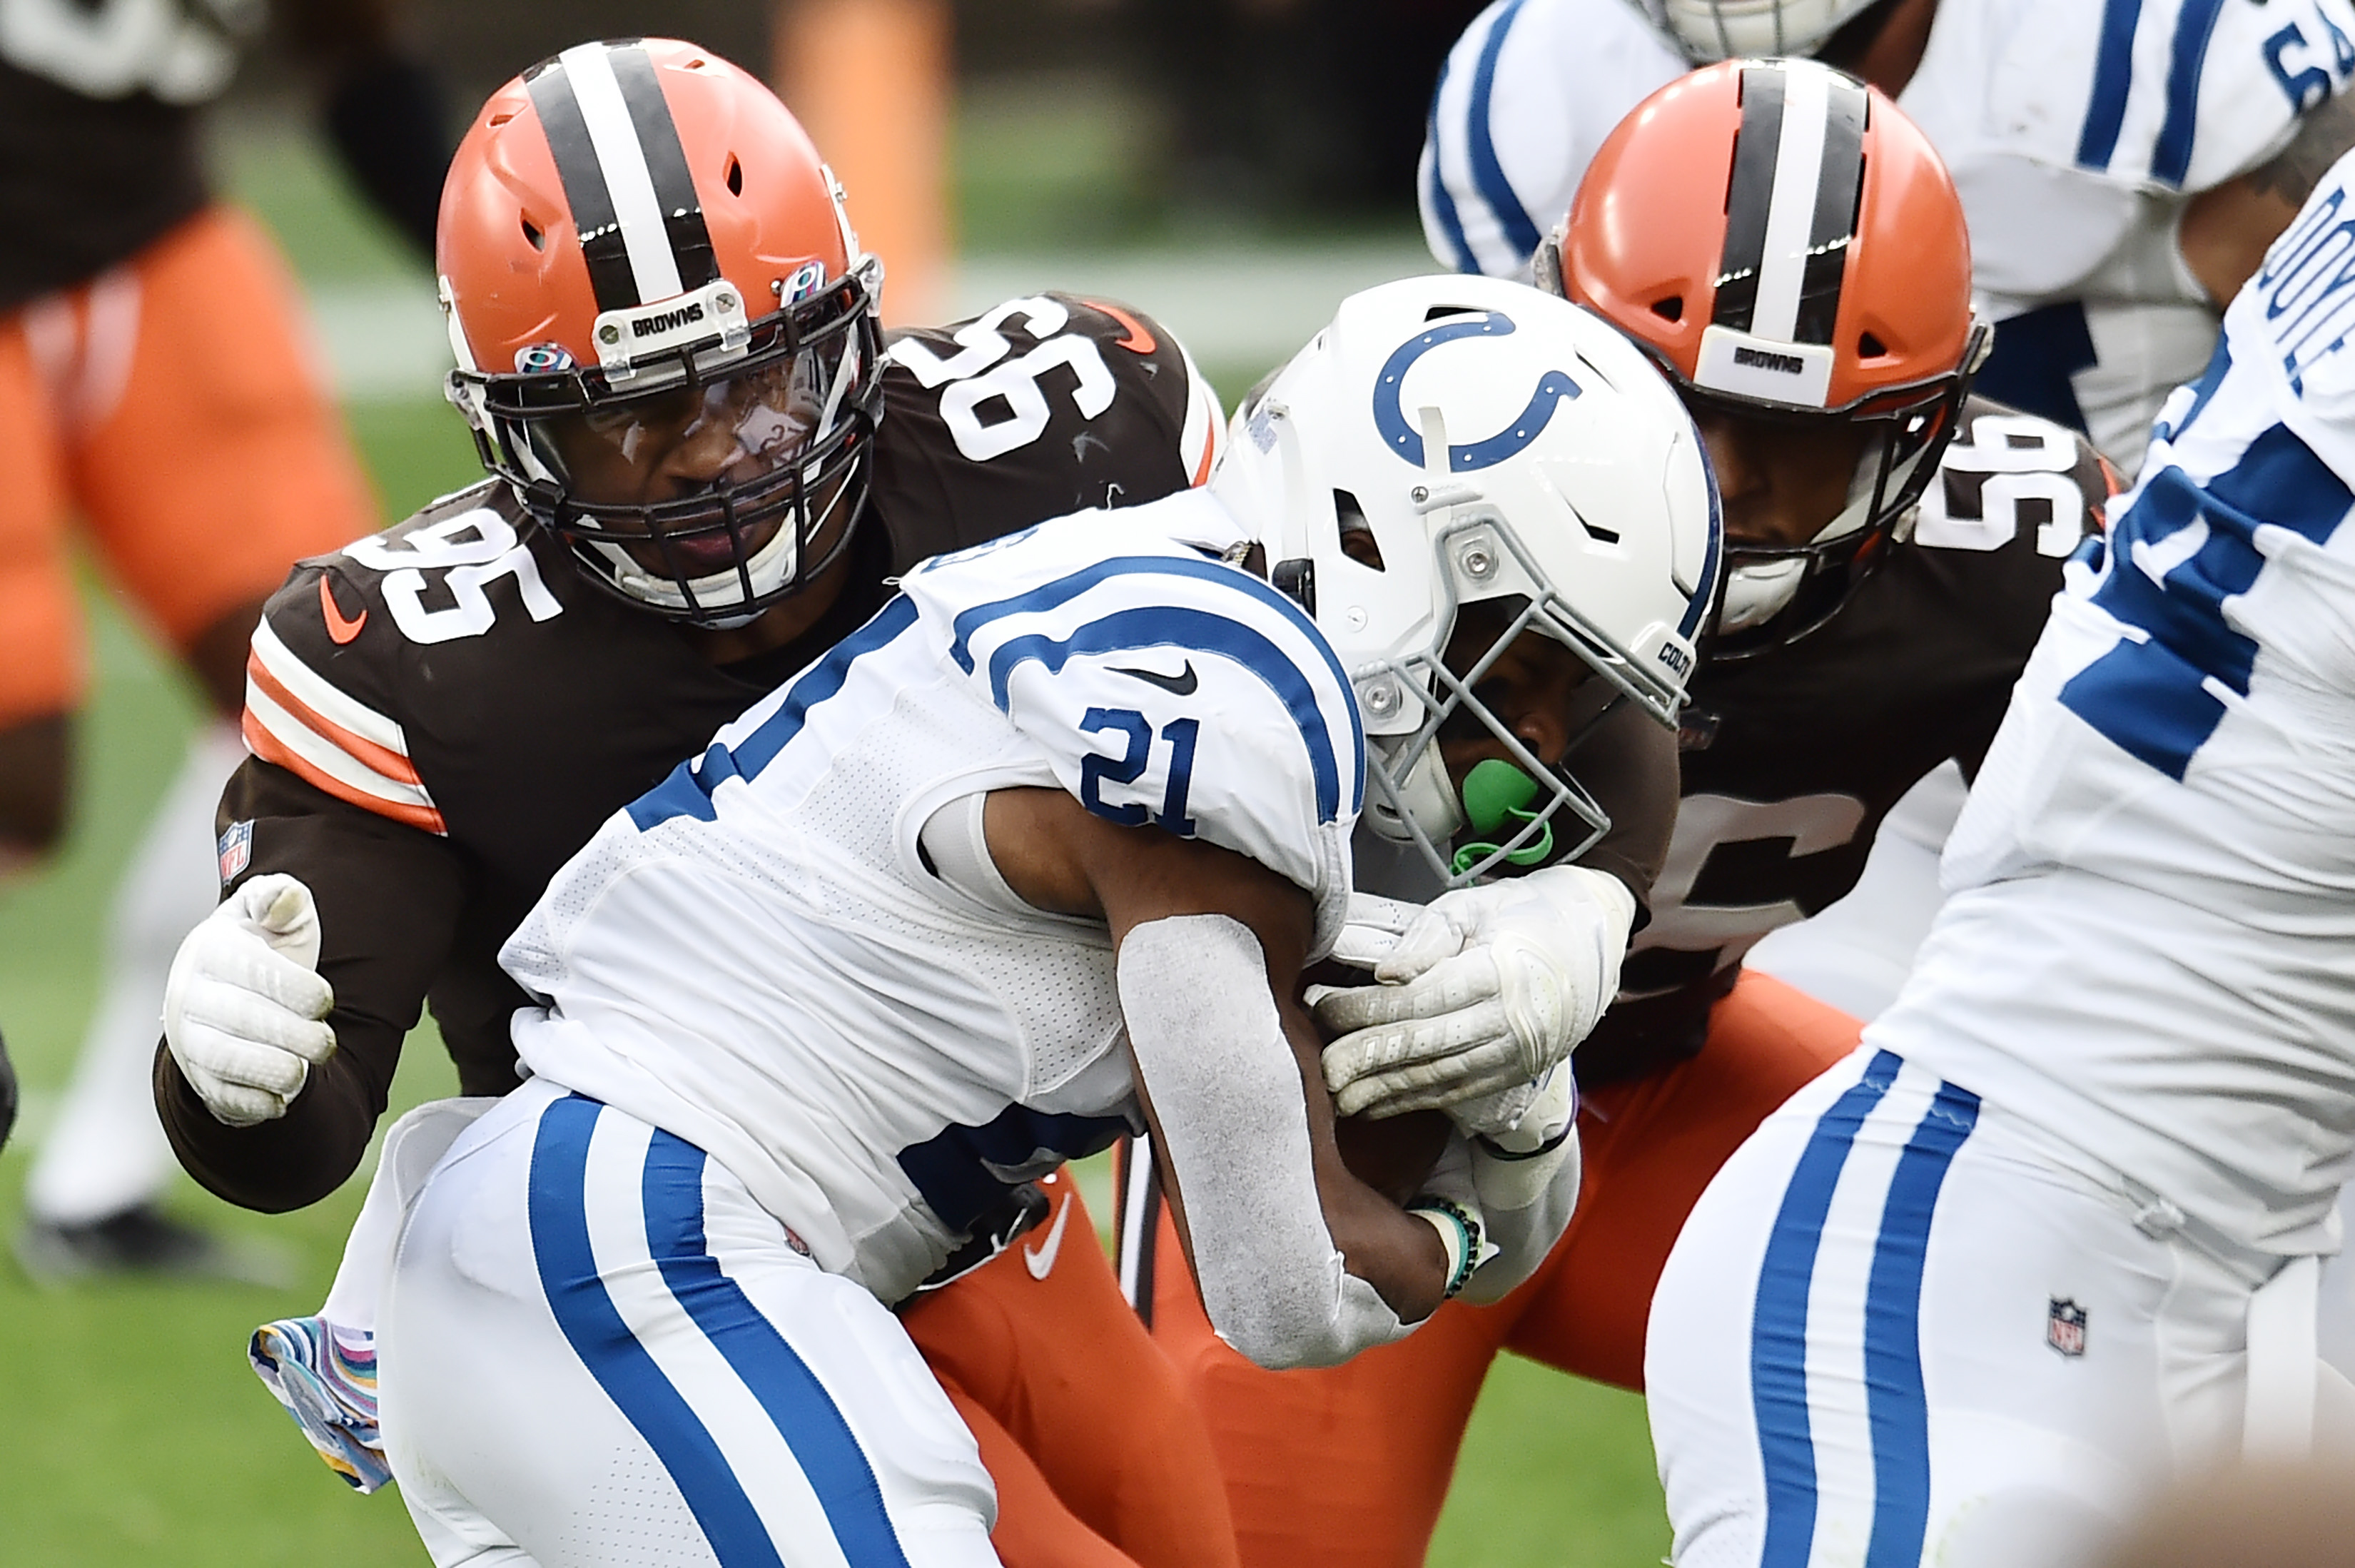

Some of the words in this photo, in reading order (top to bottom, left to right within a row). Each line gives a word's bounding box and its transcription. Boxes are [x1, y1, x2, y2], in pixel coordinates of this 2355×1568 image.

[632, 303, 704, 338] BROWNS
[888, 297, 1116, 462] 95
[1734, 347, 1803, 375] BROWNS
[1914, 415, 2082, 558] 56
[342, 508, 563, 644] 95
[1078, 707, 1200, 836] 21
[220, 844, 245, 879] NFL
